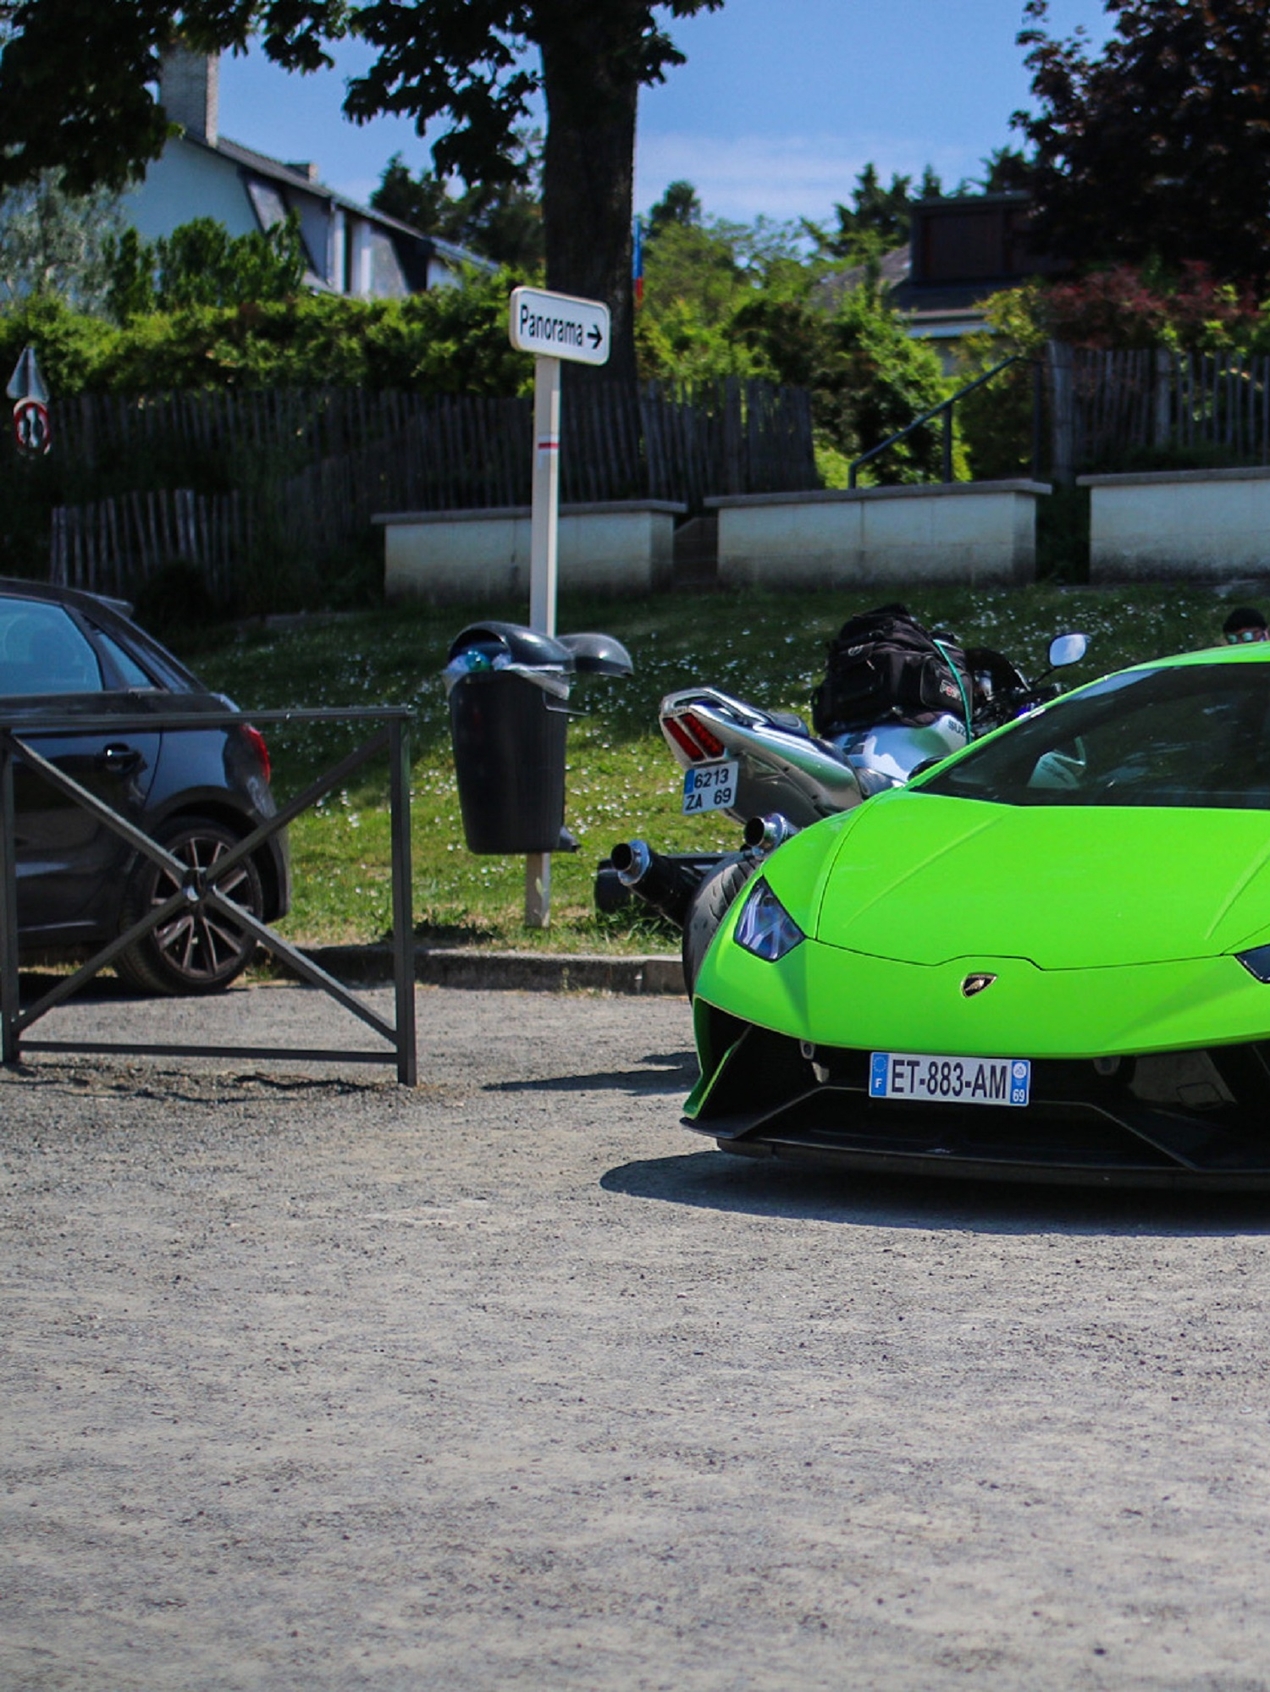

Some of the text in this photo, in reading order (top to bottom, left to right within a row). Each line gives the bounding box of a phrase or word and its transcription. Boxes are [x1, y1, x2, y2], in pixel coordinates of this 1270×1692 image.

[520, 304, 583, 347] Panorama
[694, 768, 729, 789] 6213
[685, 787, 732, 811] ZA 69
[874, 1059, 1025, 1103] F ET-883-AM 69
